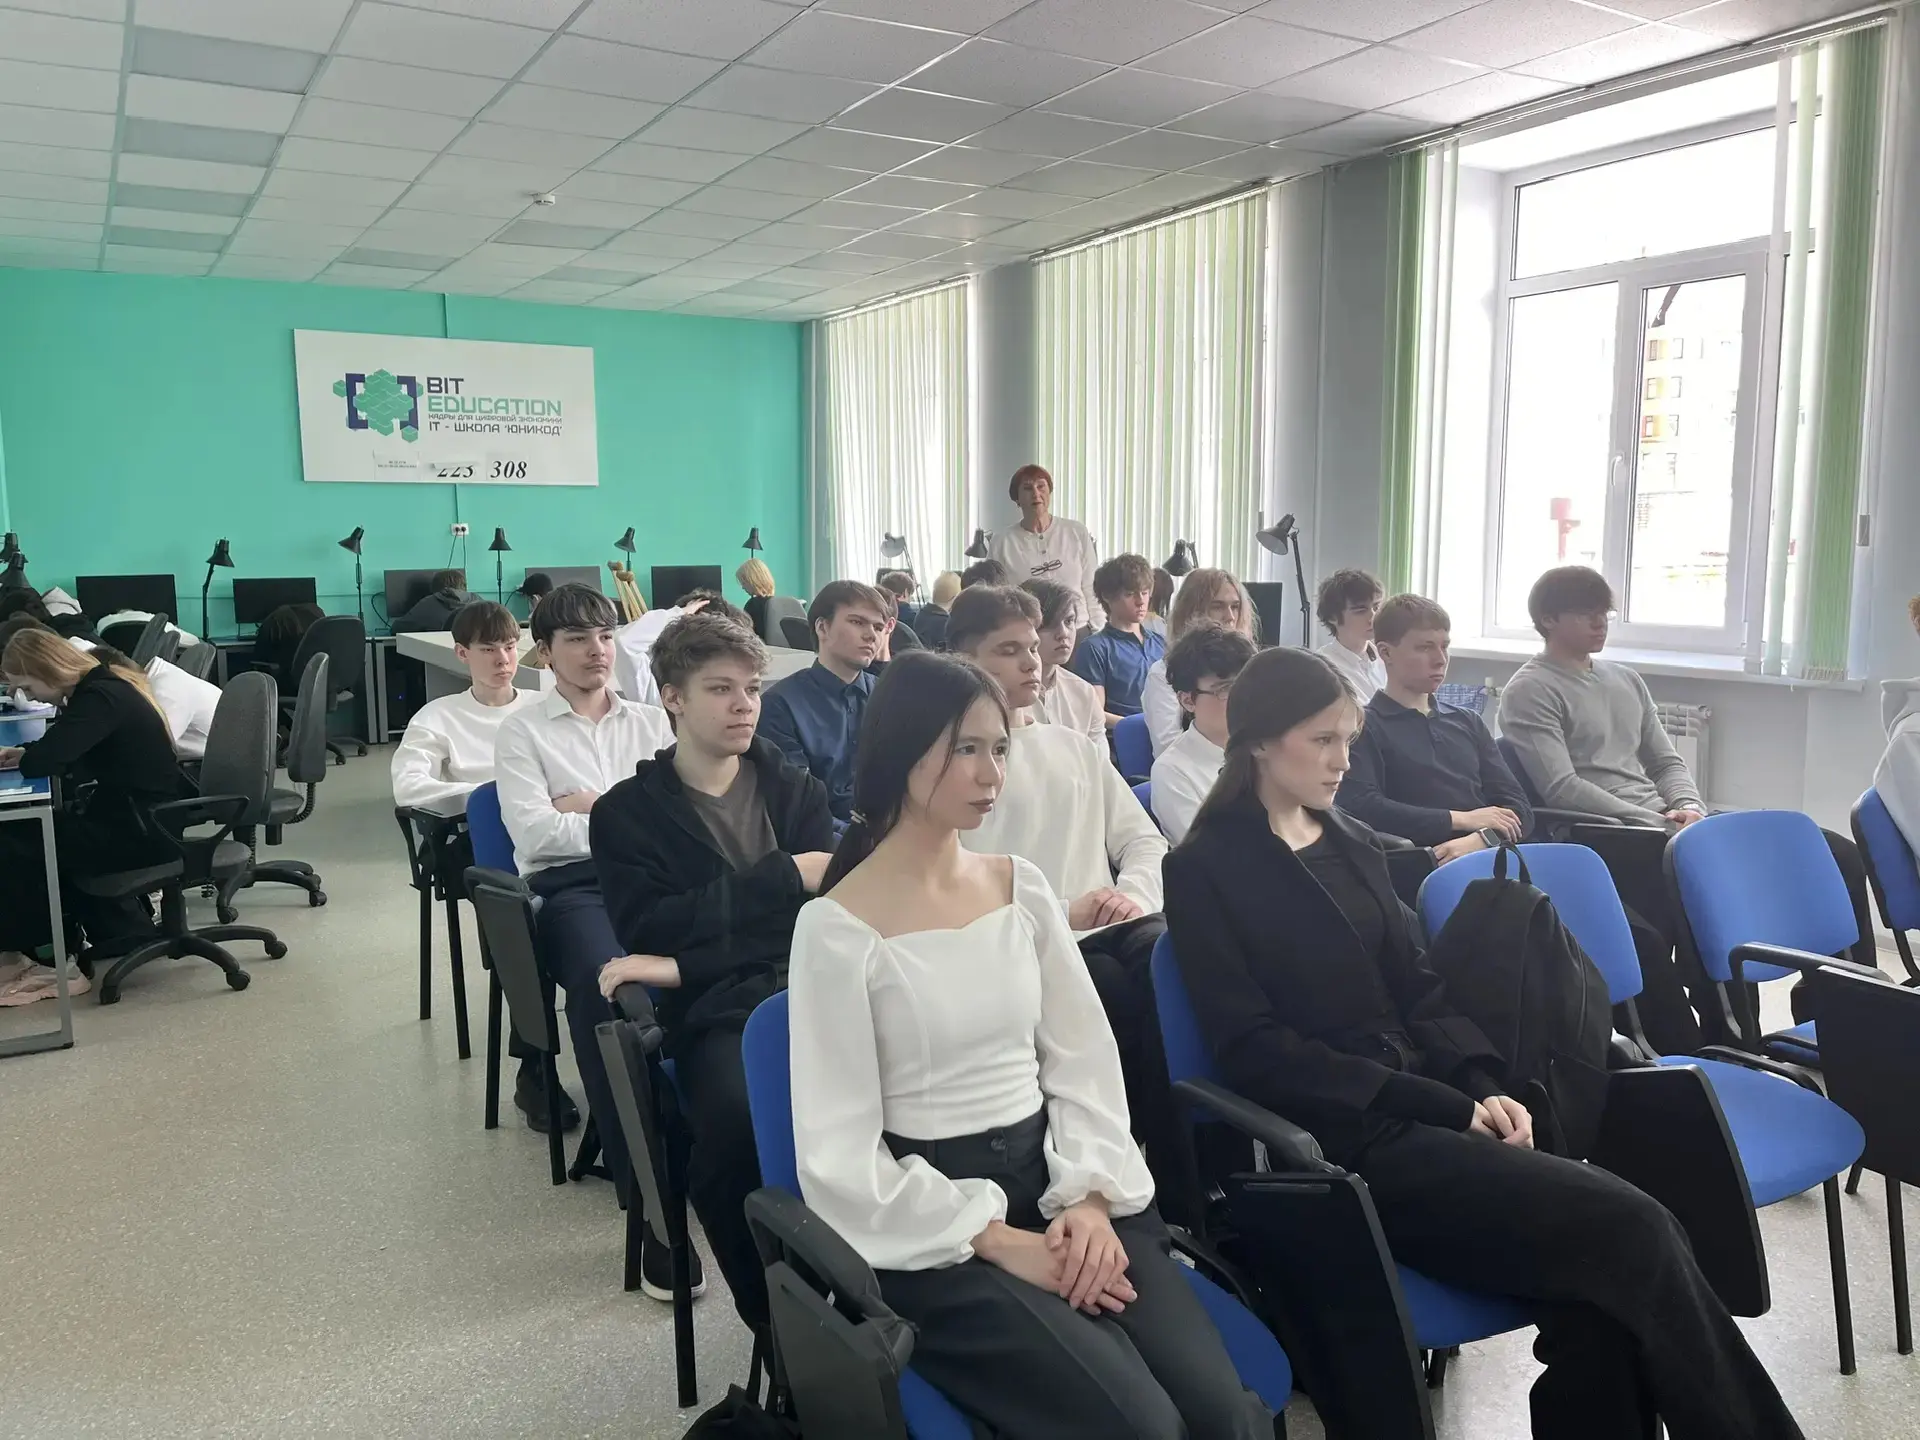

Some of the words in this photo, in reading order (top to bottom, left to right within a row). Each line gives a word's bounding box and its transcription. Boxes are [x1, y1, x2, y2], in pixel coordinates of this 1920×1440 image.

[427, 377, 464, 394] BIT
[428, 395, 561, 416] EDUCATION
[428, 413, 456, 421] КАДРЫ
[457, 414, 473, 422] ДЛЯ
[475, 414, 517, 423] ЦИФРОВОЙ
[518, 416, 562, 424] ЭКОНОМИКИ
[429, 421, 440, 431] IT
[454, 422, 500, 433] ШКОЛА
[490, 460, 528, 479] 308
